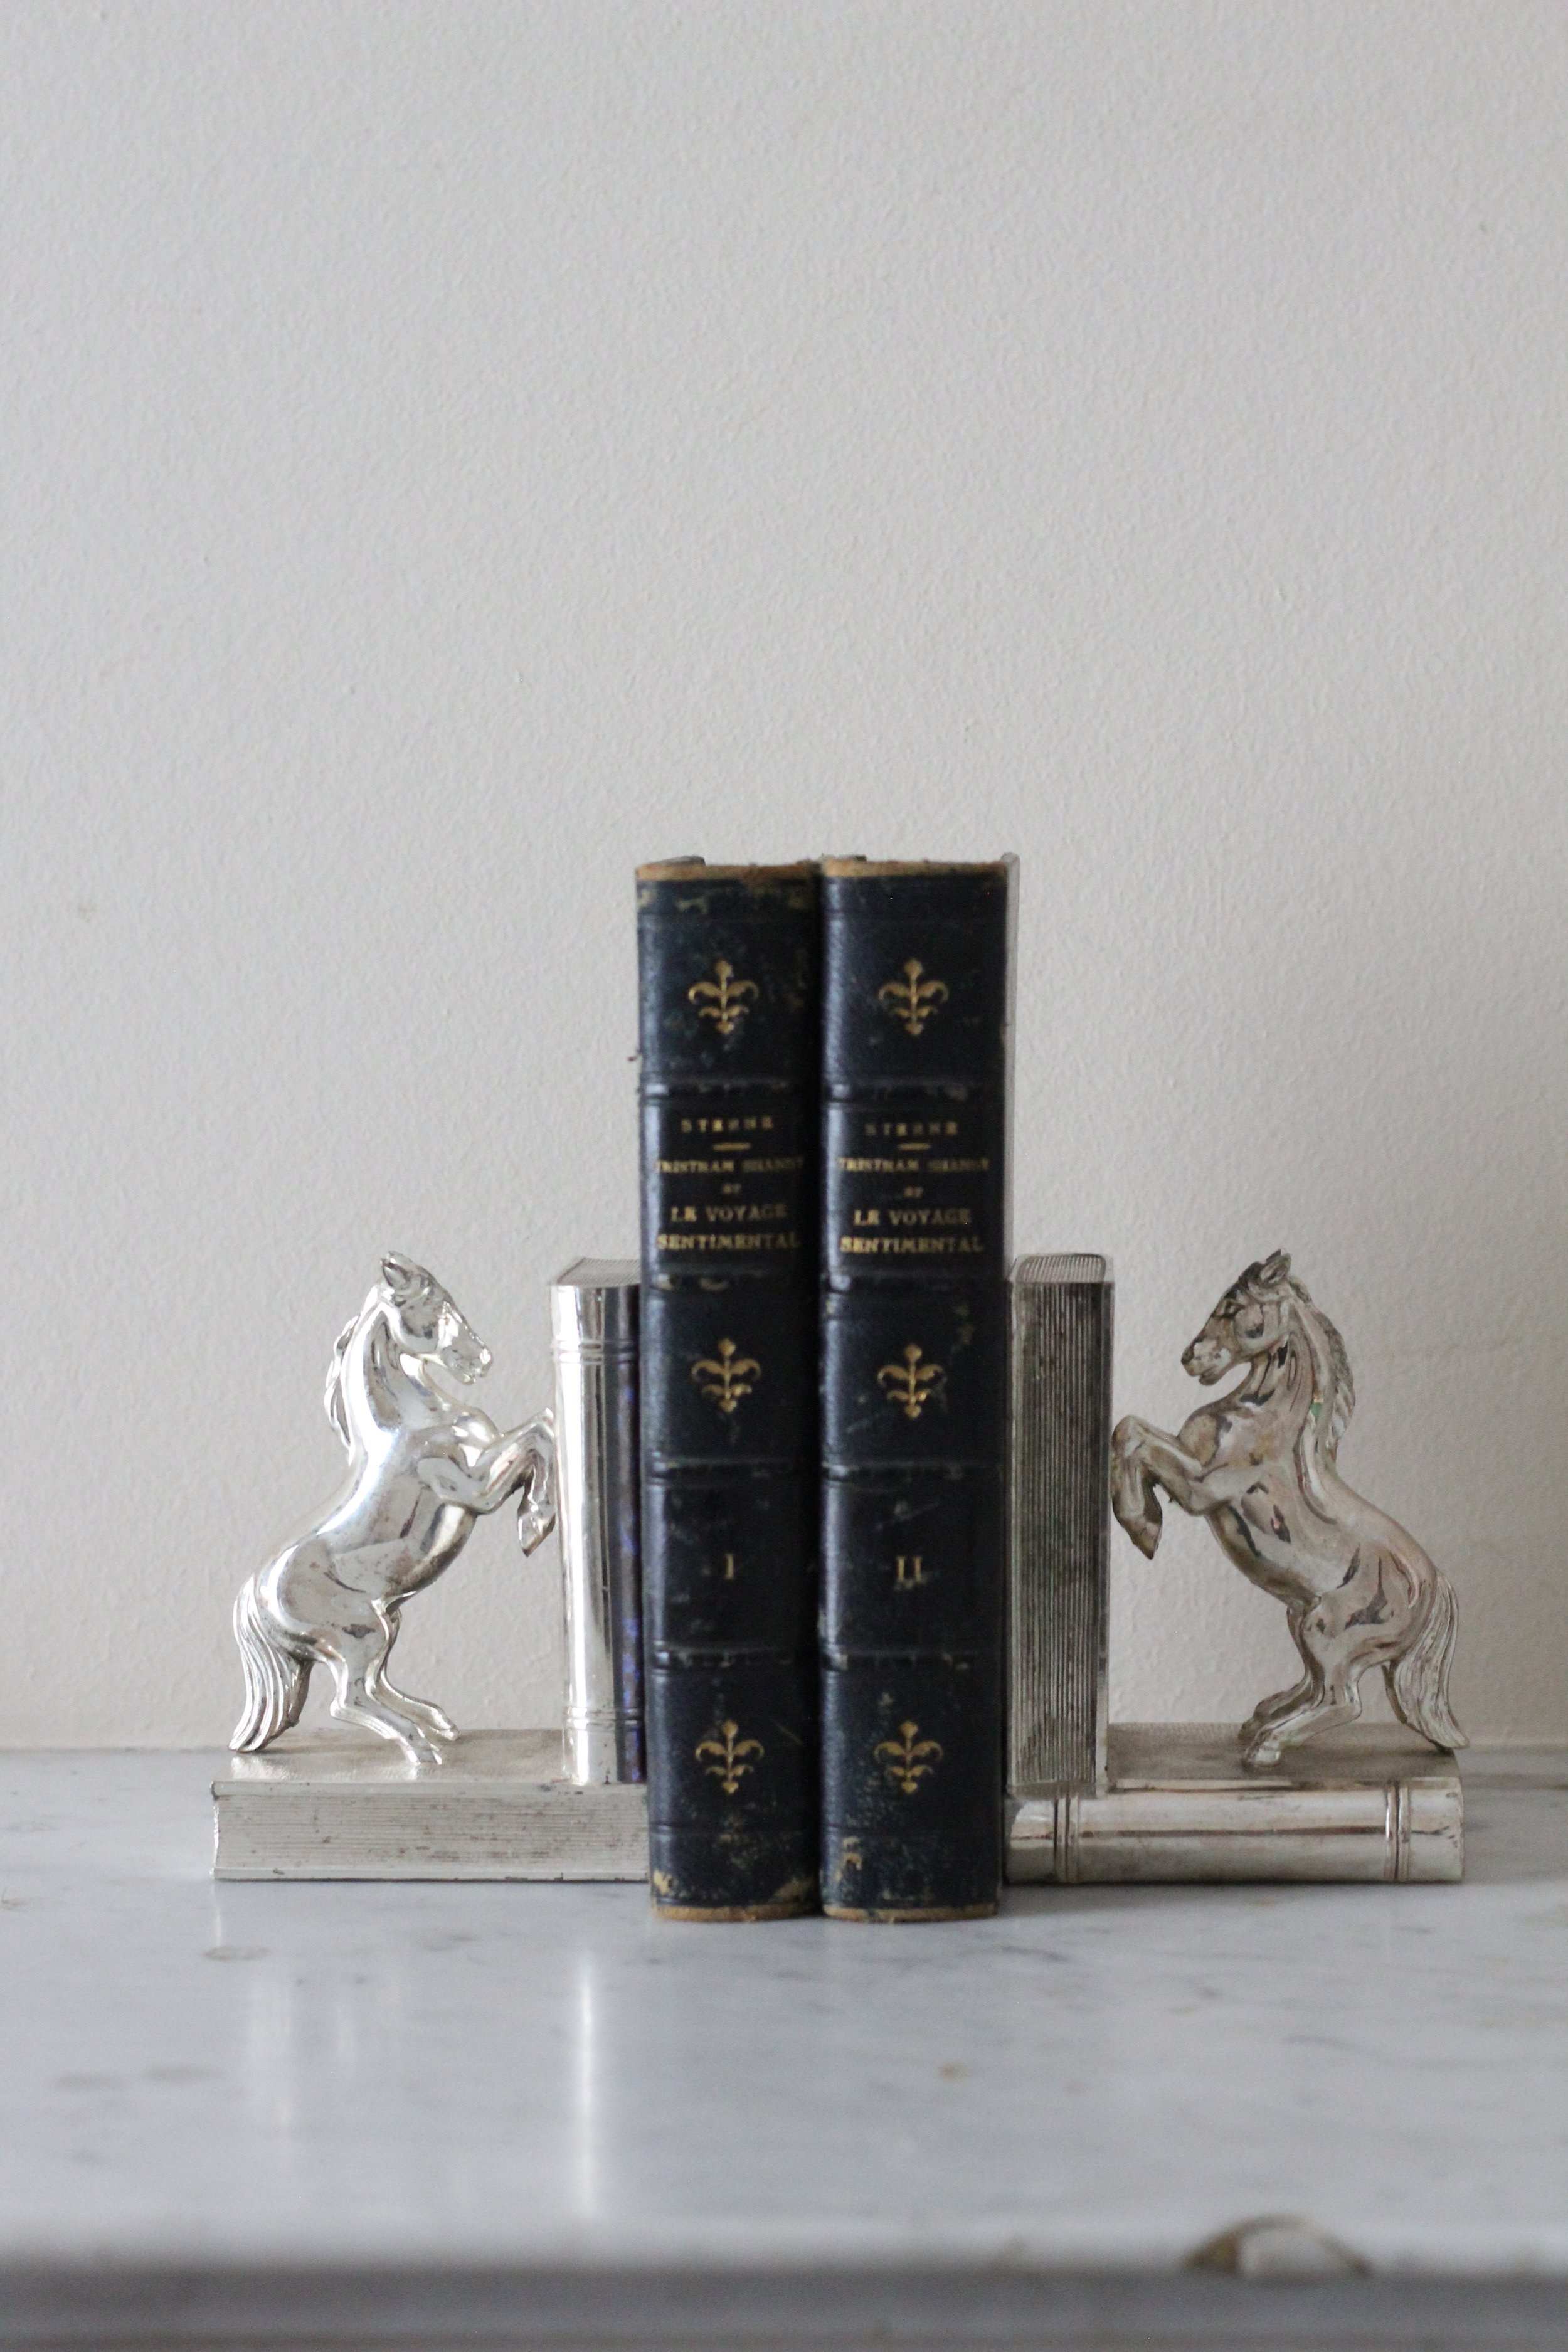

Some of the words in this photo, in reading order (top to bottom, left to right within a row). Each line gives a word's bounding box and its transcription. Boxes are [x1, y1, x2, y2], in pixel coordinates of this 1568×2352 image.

[670, 1205, 697, 1222] LE
[705, 1203, 788, 1222] VOYAGE
[853, 1209, 880, 1226] LE
[887, 1208, 972, 1226] VOYAGE
[657, 1232, 800, 1251] SENTIMENTAL
[840, 1236, 984, 1253] SENTIMENTAL
